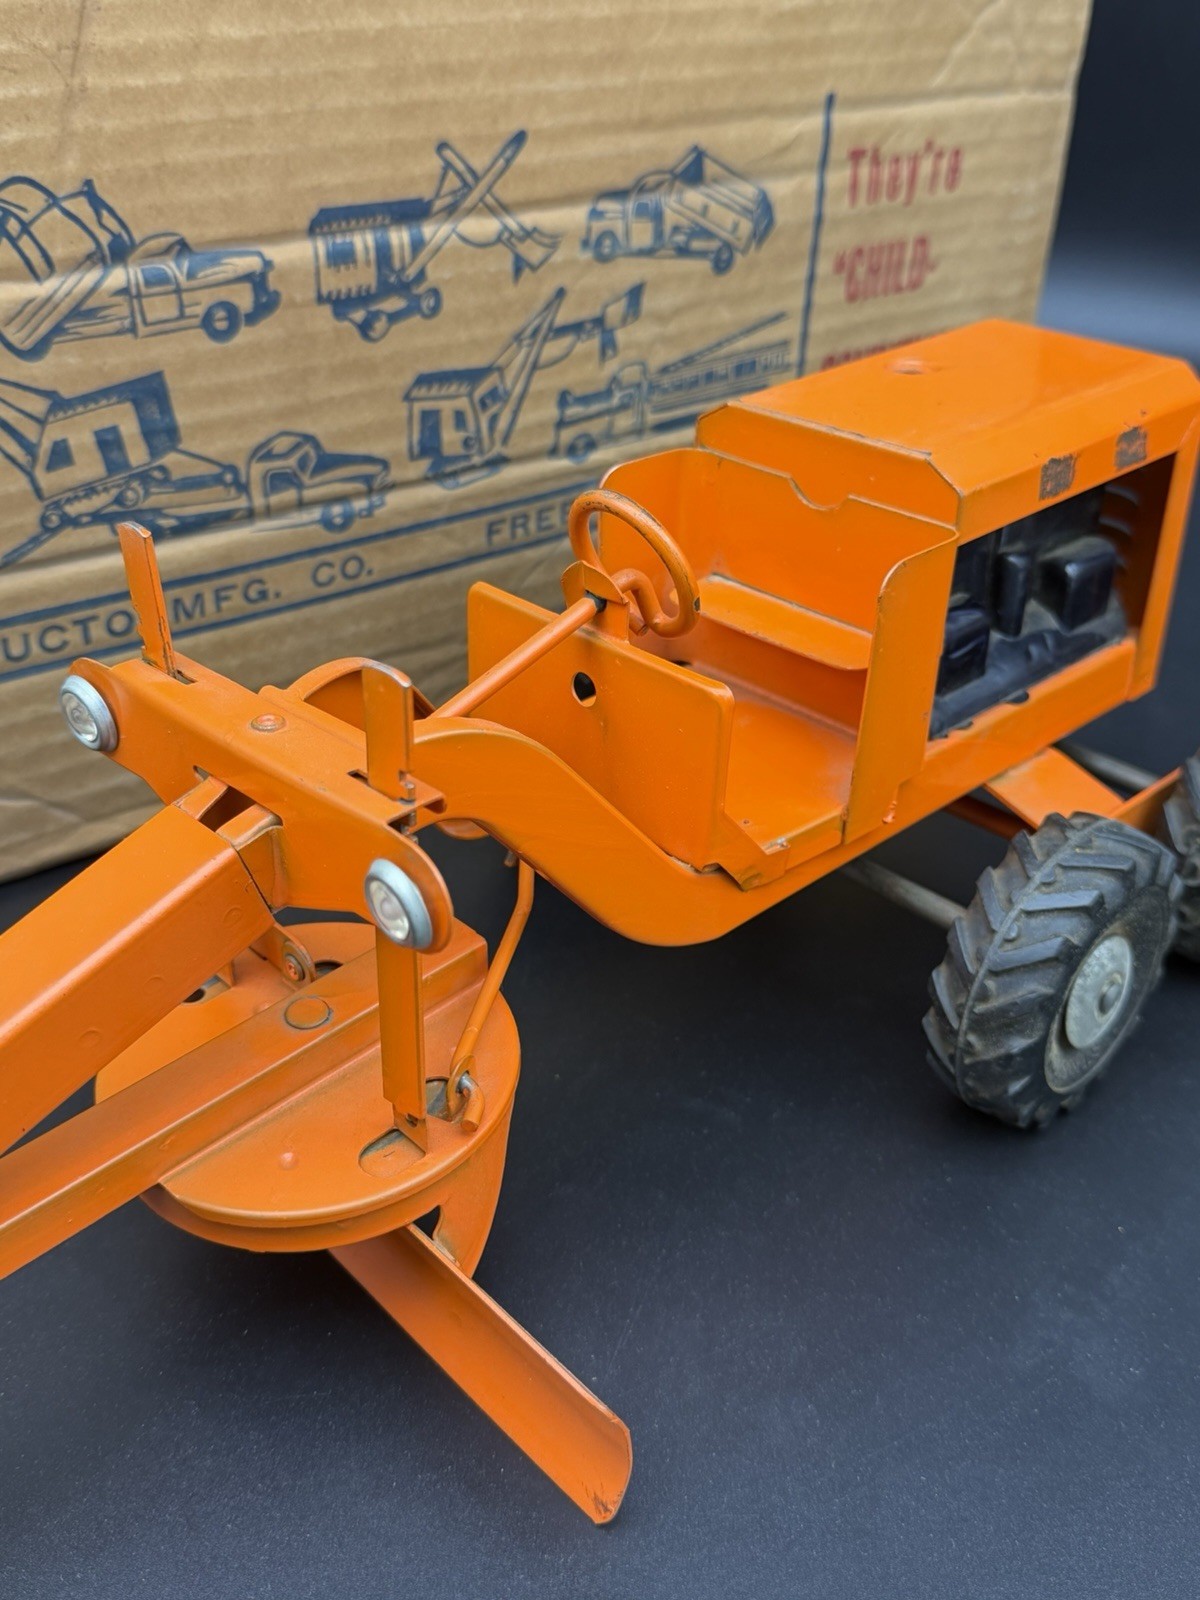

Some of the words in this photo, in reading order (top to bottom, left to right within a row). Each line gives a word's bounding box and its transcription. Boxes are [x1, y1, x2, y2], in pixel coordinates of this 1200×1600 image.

[847, 139, 963, 208] They're
[2, 610, 135, 663] UCTO
[171, 578, 282, 624] MFG.
[311, 554, 374, 588] CO.
